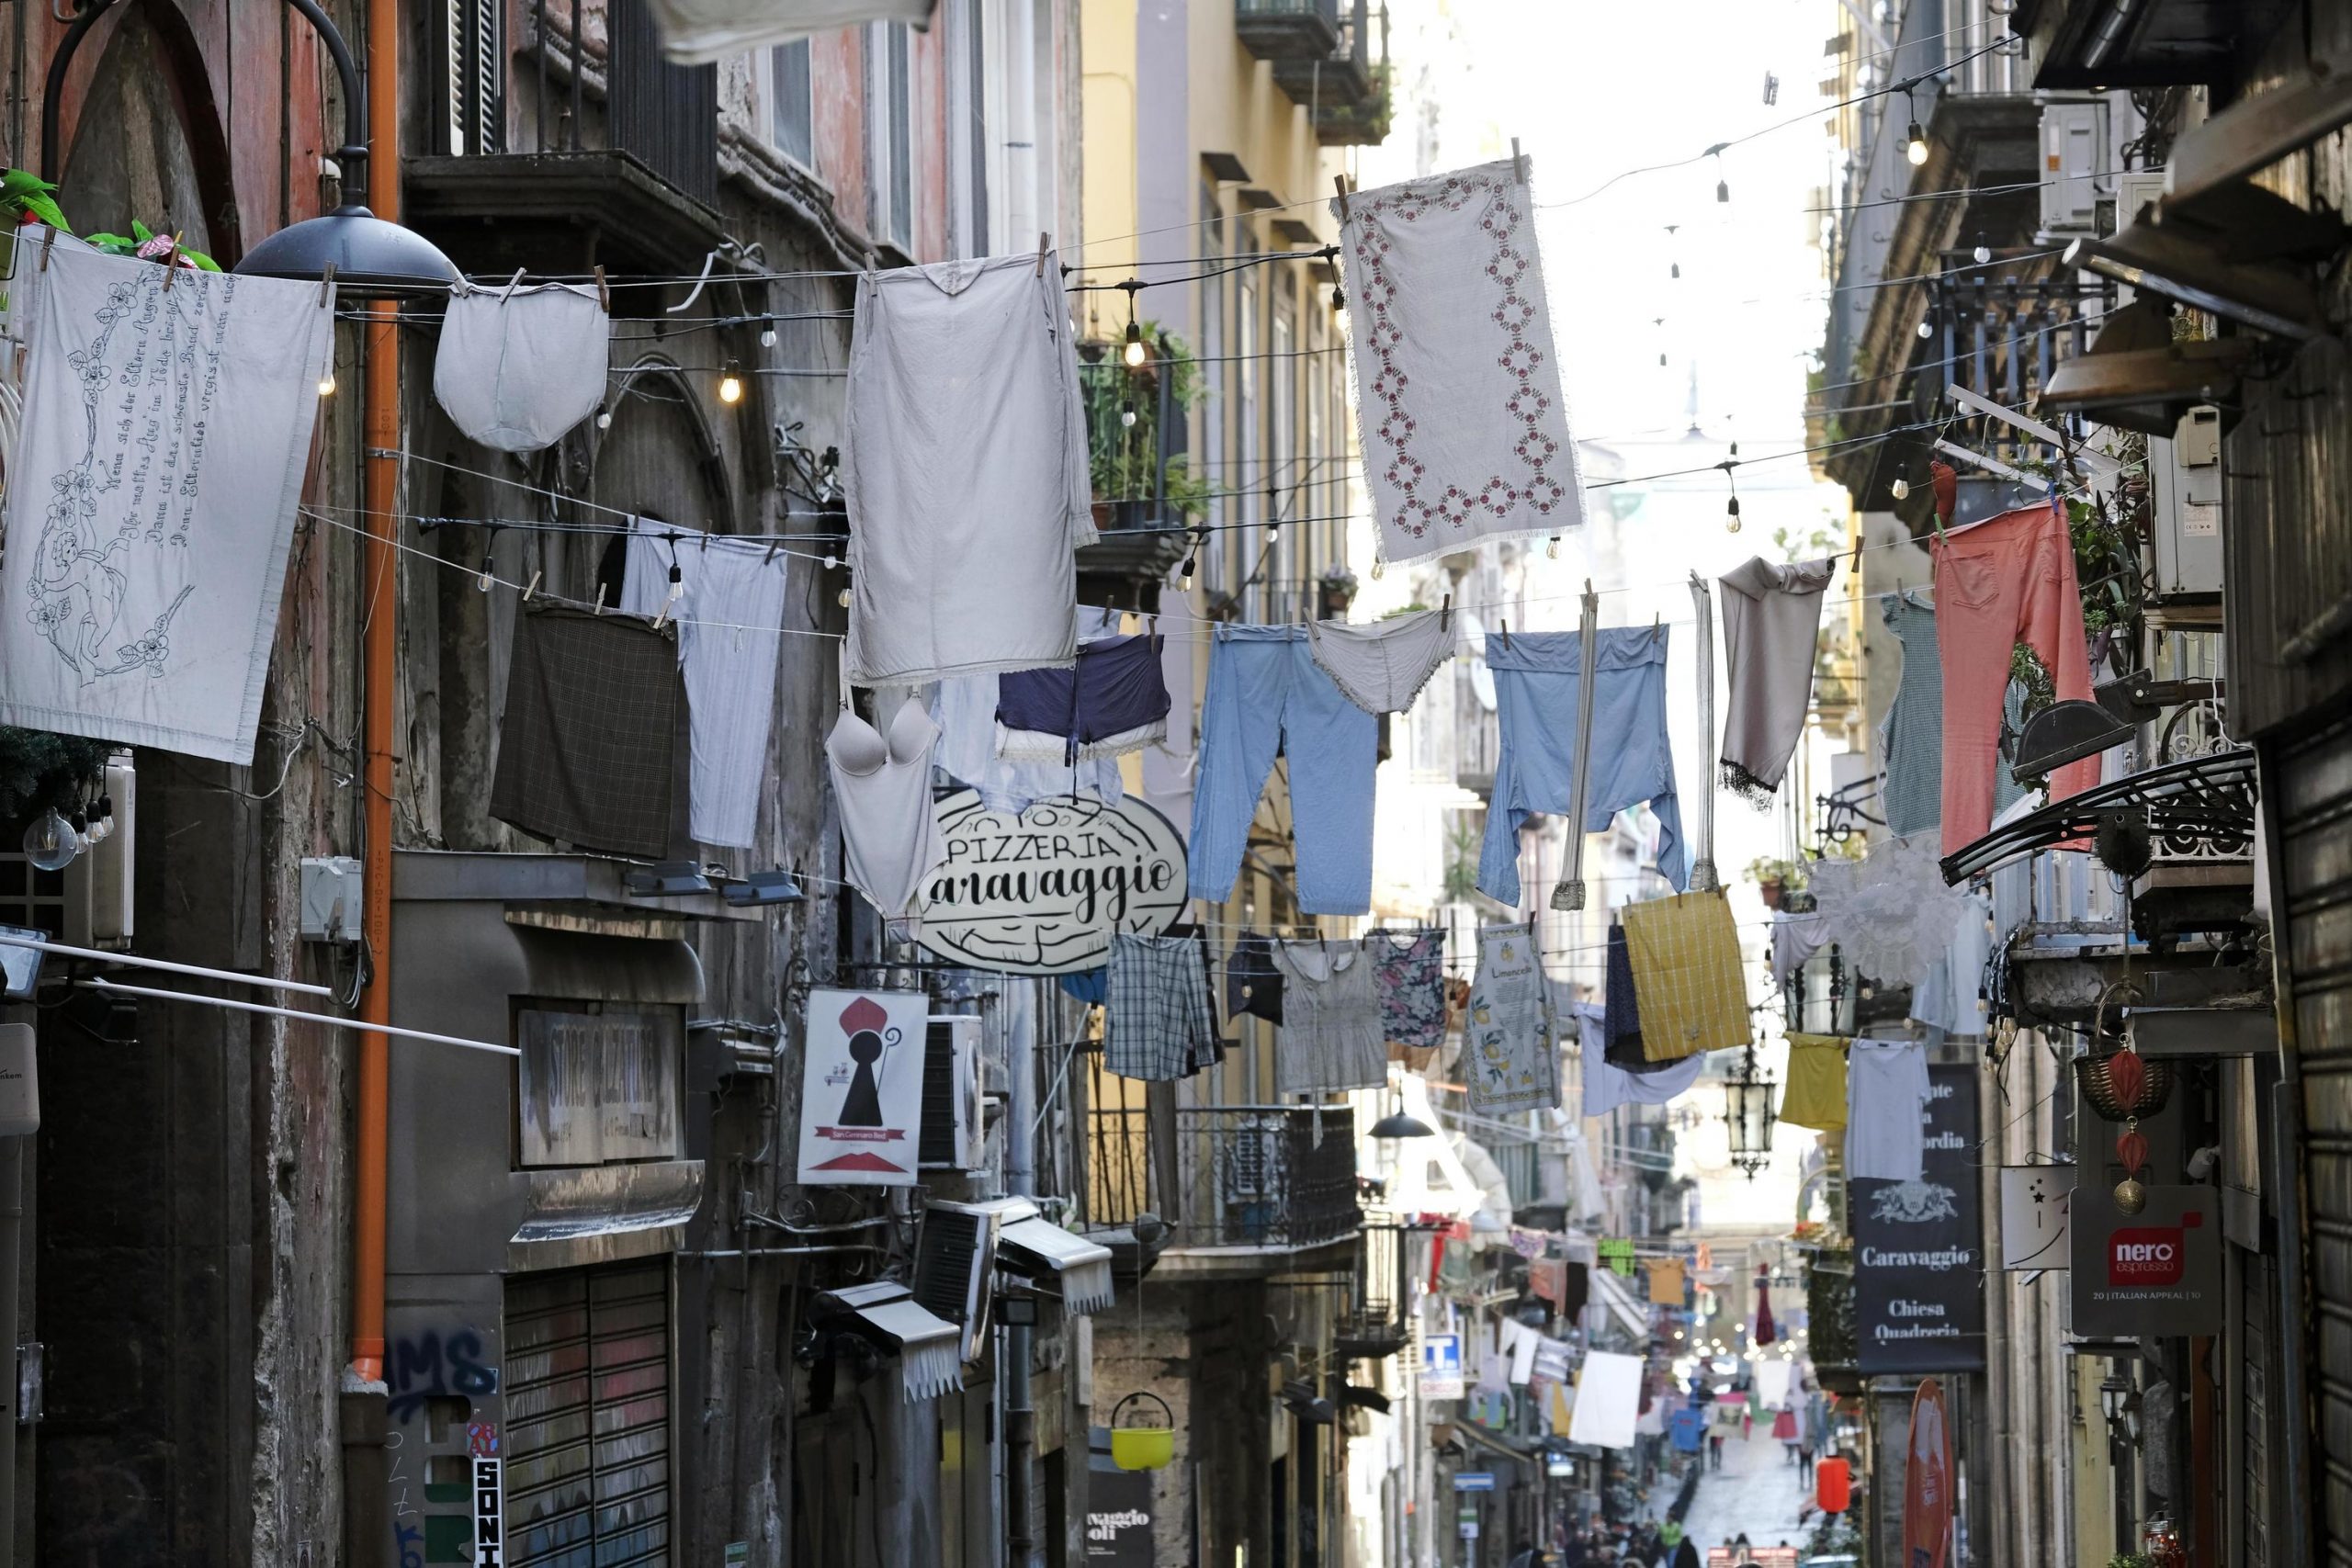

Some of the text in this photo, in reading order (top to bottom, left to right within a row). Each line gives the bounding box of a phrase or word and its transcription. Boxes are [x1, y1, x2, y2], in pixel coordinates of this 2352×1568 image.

[120, 391, 136, 413] der
[118, 419, 133, 446] sich
[164, 442, 179, 468] das
[947, 832, 1121, 863] PIZZERIA
[922, 854, 1179, 924] aravaggio
[1860, 1245, 1970, 1271] Caravaggio
[2117, 1243, 2173, 1261] nero
[2117, 1261, 2174, 1274] espresso
[1888, 1299, 1945, 1317] Chiesa
[2093, 1292, 2105, 1301] 20
[2111, 1292, 2148, 1300] ITALIAN
[2150, 1292, 2184, 1300] APPEAL
[1874, 1323, 1961, 1346] Quadreria
